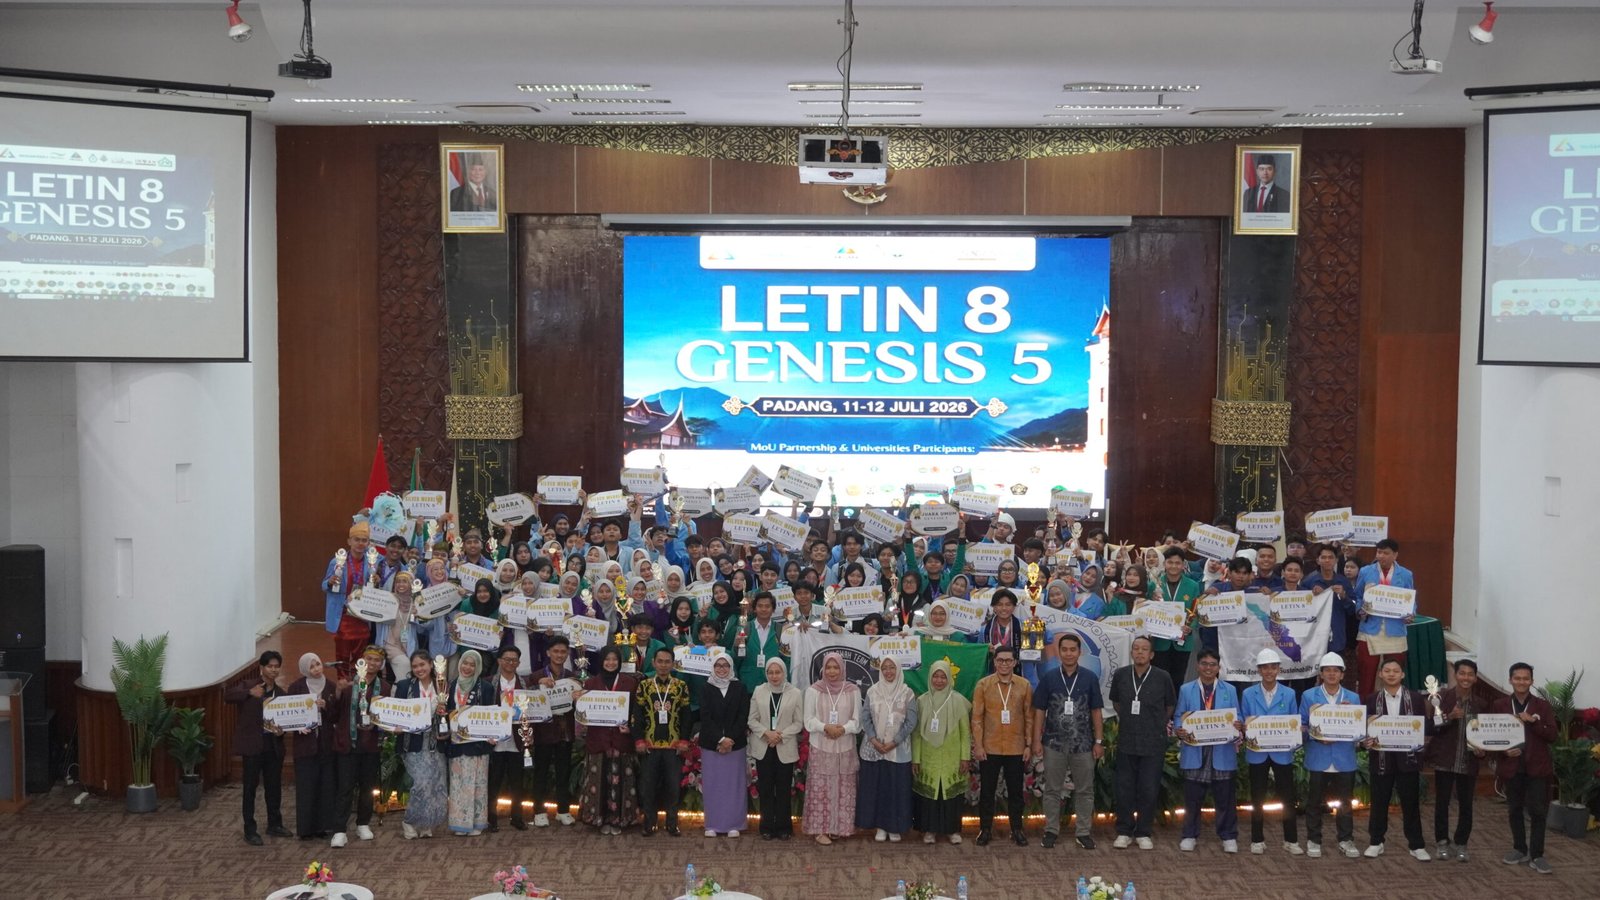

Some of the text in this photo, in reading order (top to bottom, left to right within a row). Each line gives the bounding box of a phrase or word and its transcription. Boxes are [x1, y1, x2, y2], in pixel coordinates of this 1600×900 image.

[7, 171, 164, 203] LETIN 8
[165, 208, 186, 231] 5
[75, 235, 98, 244] 11-12
[100, 236, 119, 244] JULI
[121, 237, 142, 245] 2026
[721, 285, 1011, 334] LETIN 8
[675, 339, 1052, 384] GENESIS 5
[763, 400, 968, 415] PADANG, 11-12 JULI 2026
[750, 442, 975, 455] MoU Partnership & Universities Participants:
[497, 501, 519, 510] JUARA
[772, 524, 790, 536] LETIN
[869, 519, 888, 531] LETIN
[1316, 521, 1336, 529] LETIN
[1199, 535, 1219, 547] LETIN
[950, 610, 968, 620] ETIN
[1146, 617, 1166, 626] LETIN
[464, 626, 485, 635] LETIN
[684, 654, 706, 662] LETIN
[1280, 665, 1313, 674] Sustainability
[546, 688, 568, 696] UARA
[374, 702, 412, 712] GOLD MEDAL
[382, 709, 406, 718] LETIN
[468, 712, 498, 720] JUARA 2
